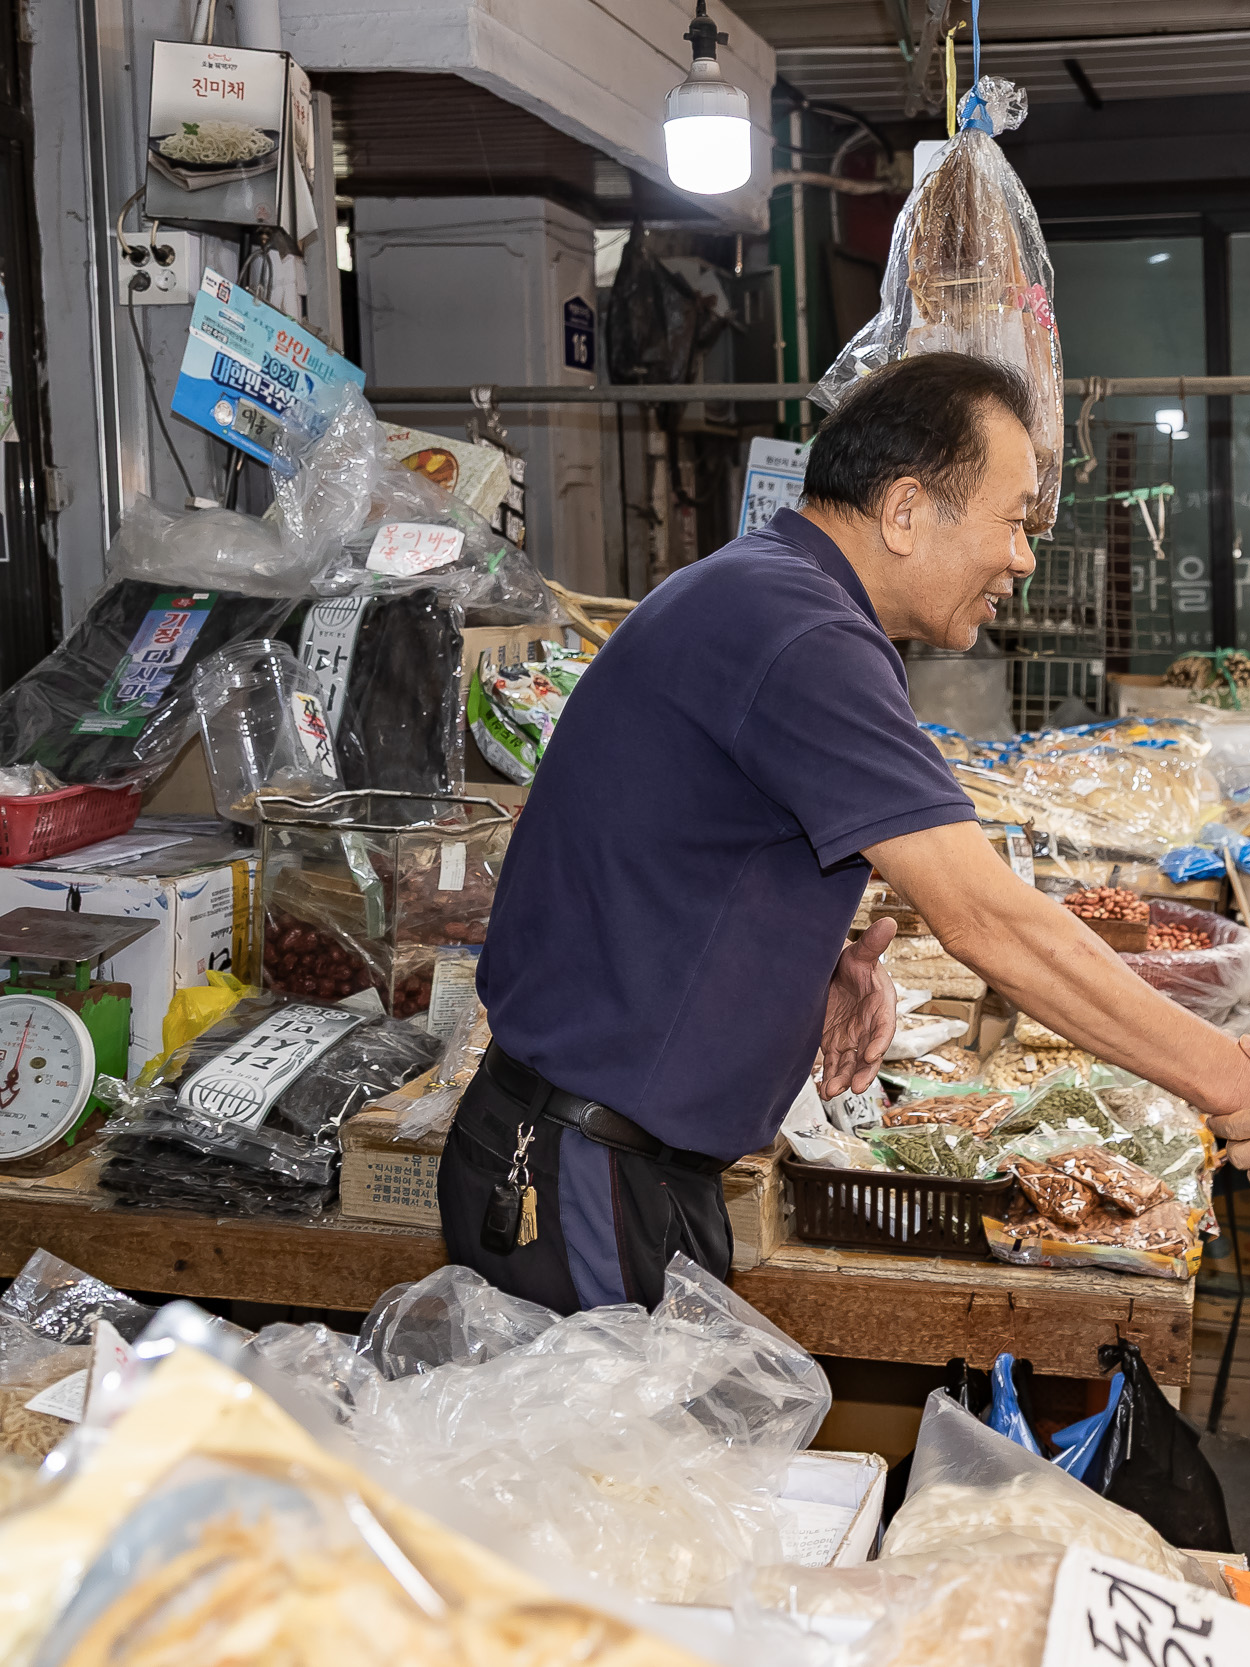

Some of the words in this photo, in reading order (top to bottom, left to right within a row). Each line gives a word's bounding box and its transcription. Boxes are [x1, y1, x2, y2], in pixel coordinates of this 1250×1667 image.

[192, 77, 245, 100] 진미채
[262, 351, 300, 391] 2021
[159, 612, 191, 644] 기장
[117, 649, 171, 701] 다시마
[223, 1020, 314, 1070] 다시마
[374, 1163, 421, 1177] 직사광선을
[374, 1174, 411, 1186] 보관하여
[373, 1184, 430, 1199] 유통과정에서
[373, 1193, 419, 1206] 판매처에서
